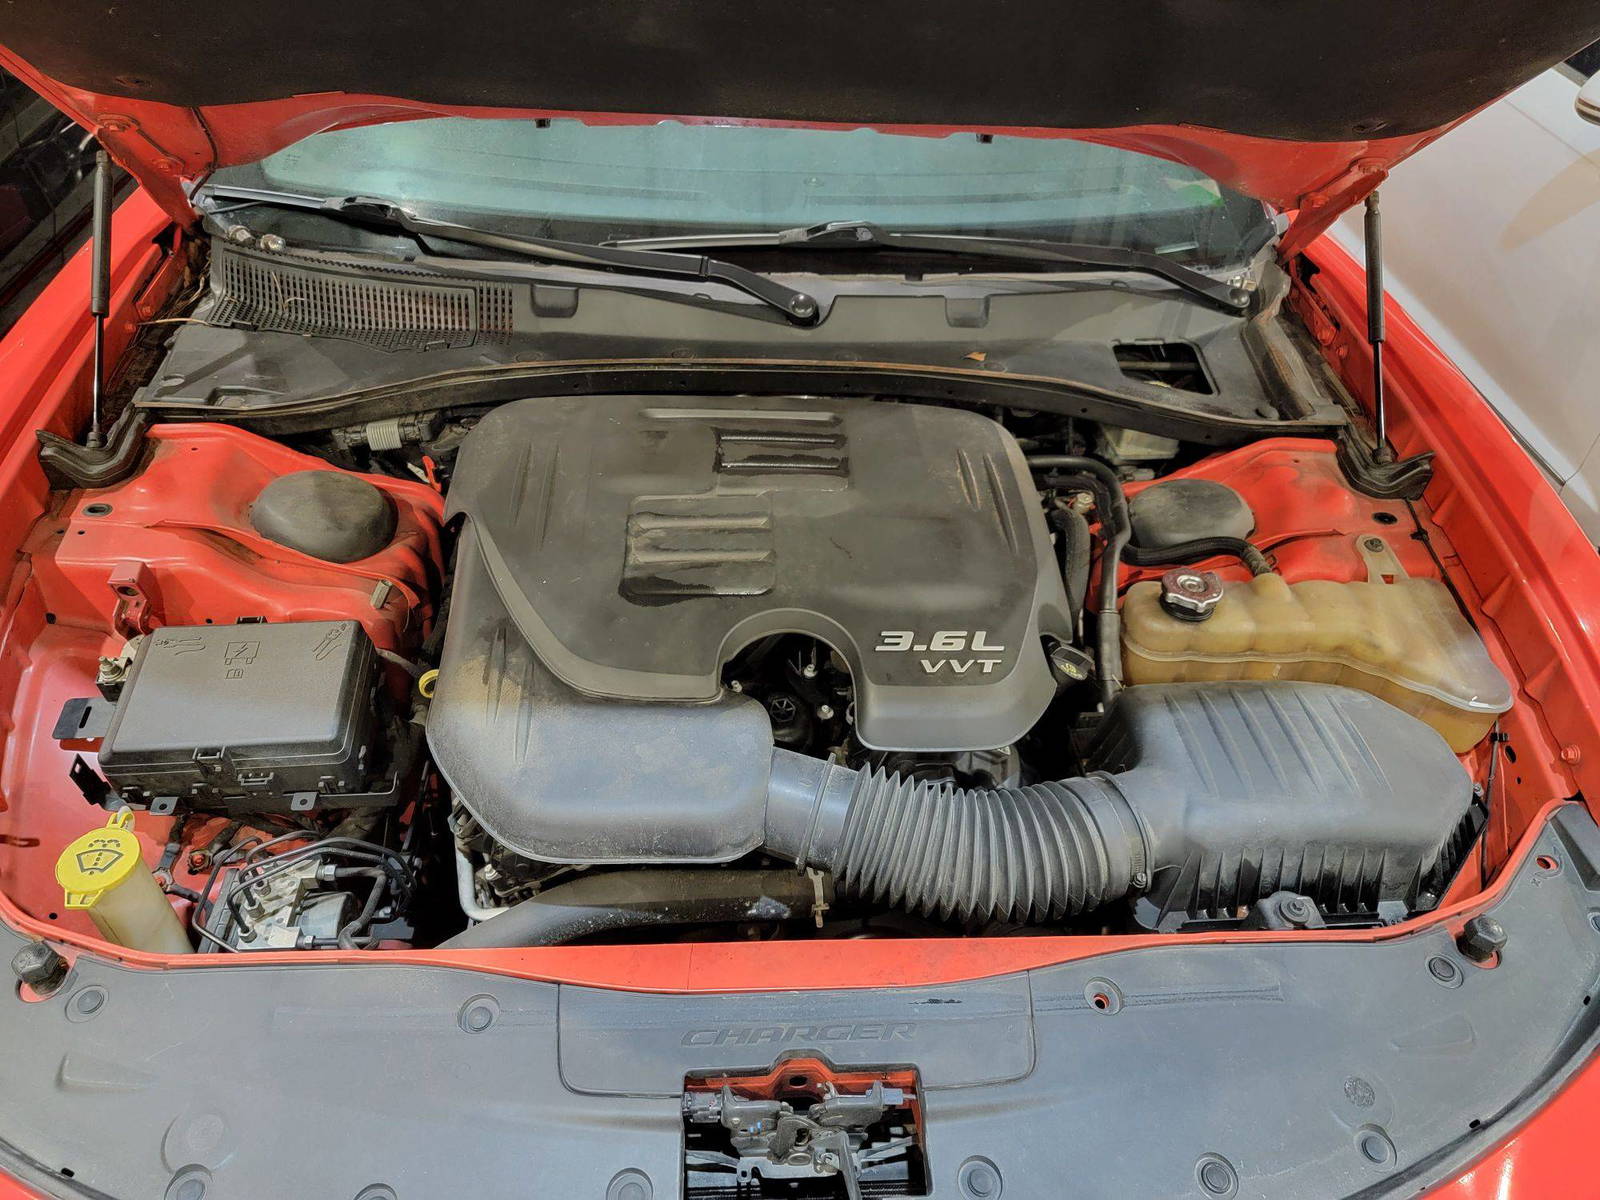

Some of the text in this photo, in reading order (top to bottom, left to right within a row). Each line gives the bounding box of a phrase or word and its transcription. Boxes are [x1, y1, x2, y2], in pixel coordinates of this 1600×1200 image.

[875, 630, 1005, 651] 3.6L
[920, 659, 1002, 673] VVT
[681, 1022, 917, 1047] CHARGER
